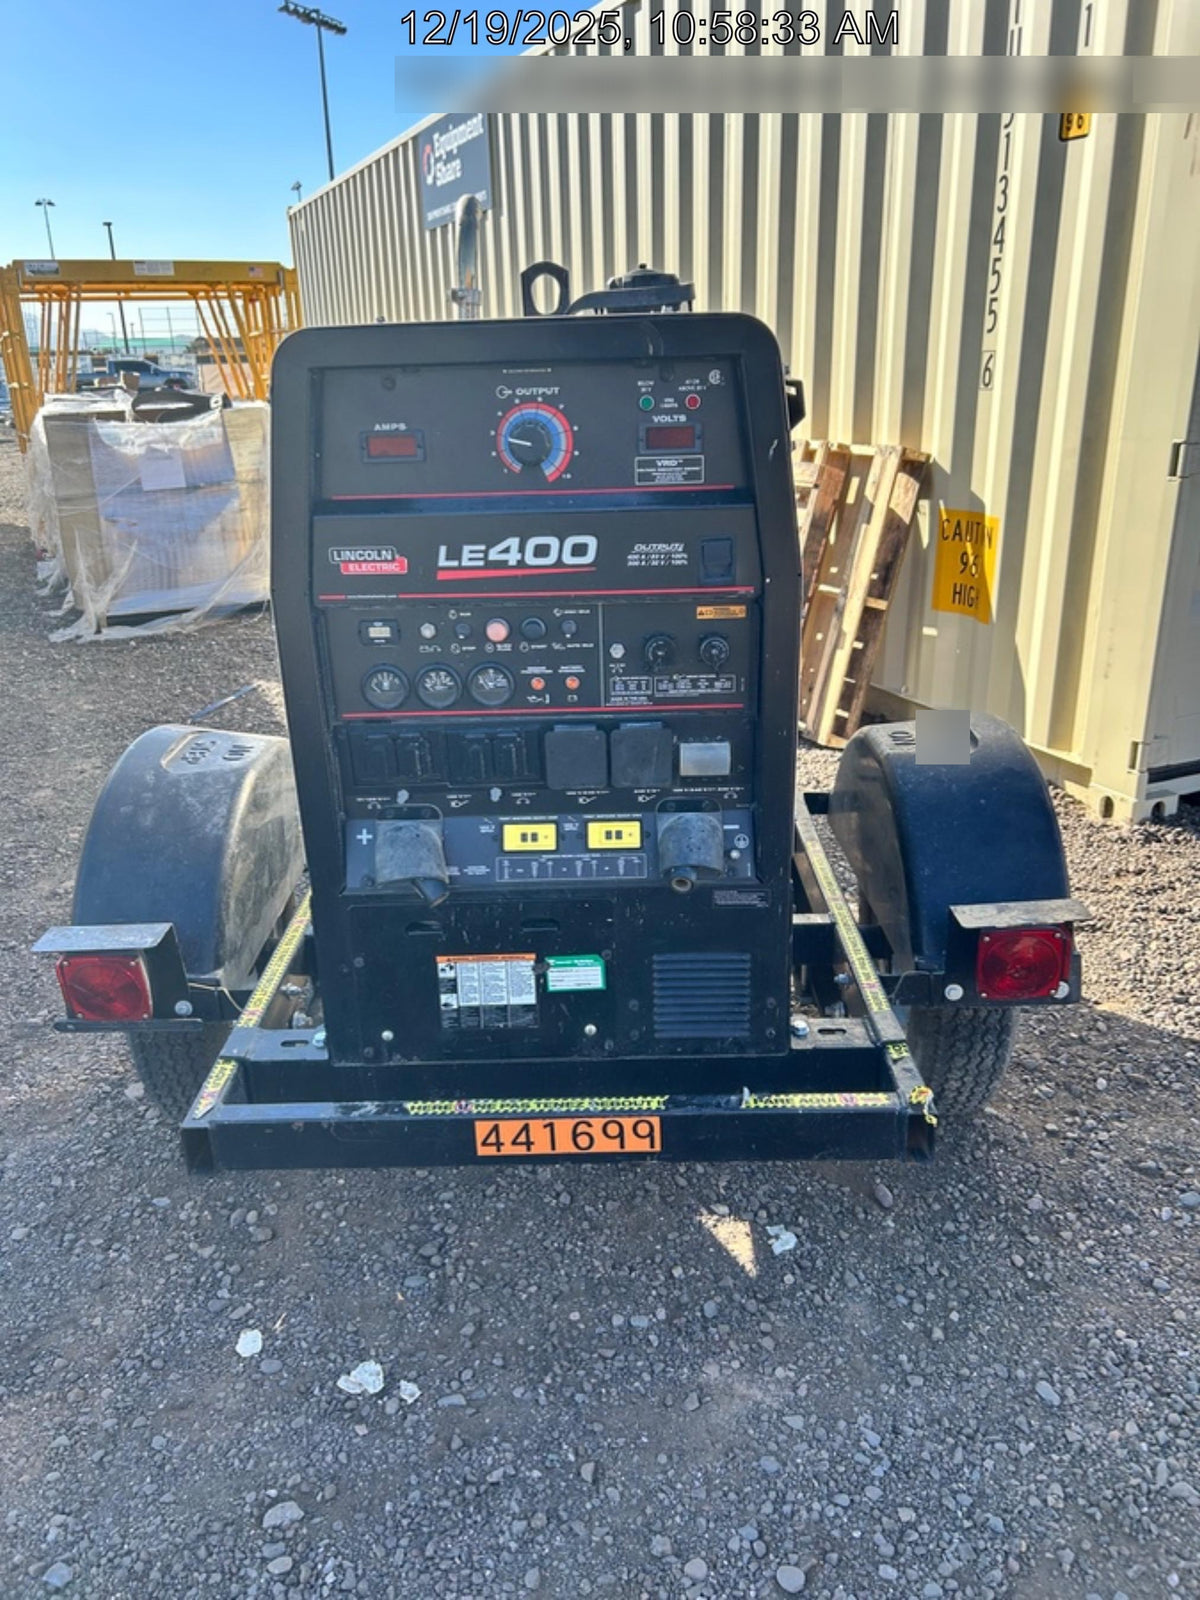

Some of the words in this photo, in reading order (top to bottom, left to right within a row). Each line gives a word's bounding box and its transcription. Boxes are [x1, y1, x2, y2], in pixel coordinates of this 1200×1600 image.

[515, 386, 560, 396] OUTPUT
[652, 414, 687, 423] VOLTS
[373, 422, 408, 431] AMPS
[941, 518, 994, 550] CAUTN
[333, 550, 392, 561] LINCOLN
[436, 534, 598, 567] LE400
[348, 562, 400, 572] ELECTRIC
[480, 1119, 656, 1153] 441699
